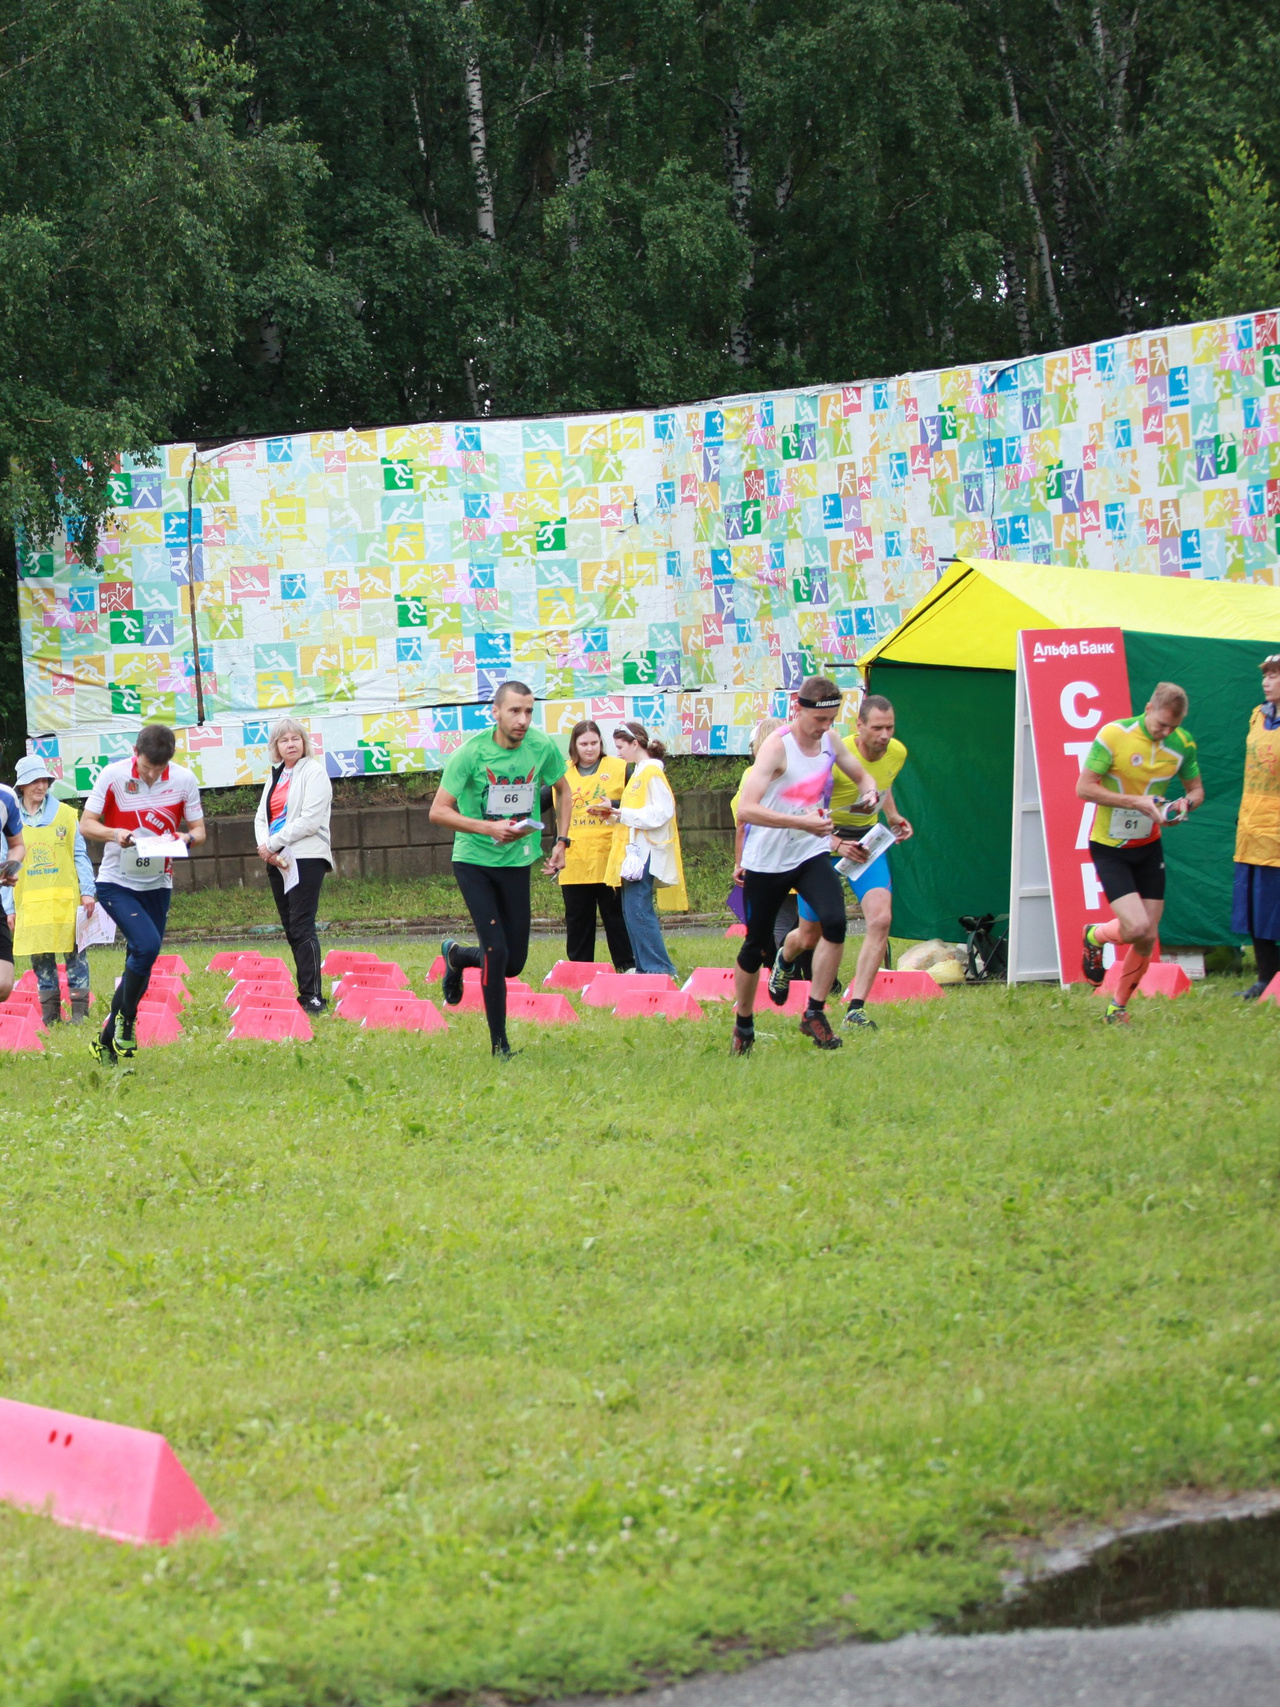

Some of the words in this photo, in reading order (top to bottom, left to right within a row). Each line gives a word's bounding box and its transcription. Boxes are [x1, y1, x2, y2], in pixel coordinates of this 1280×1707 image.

[1033, 641, 1079, 660] Альфа
[1079, 640, 1115, 655] Банк
[503, 793, 519, 804] 66
[145, 811, 165, 830] Run
[1124, 819, 1138, 830] 61
[135, 857, 151, 868] 68
